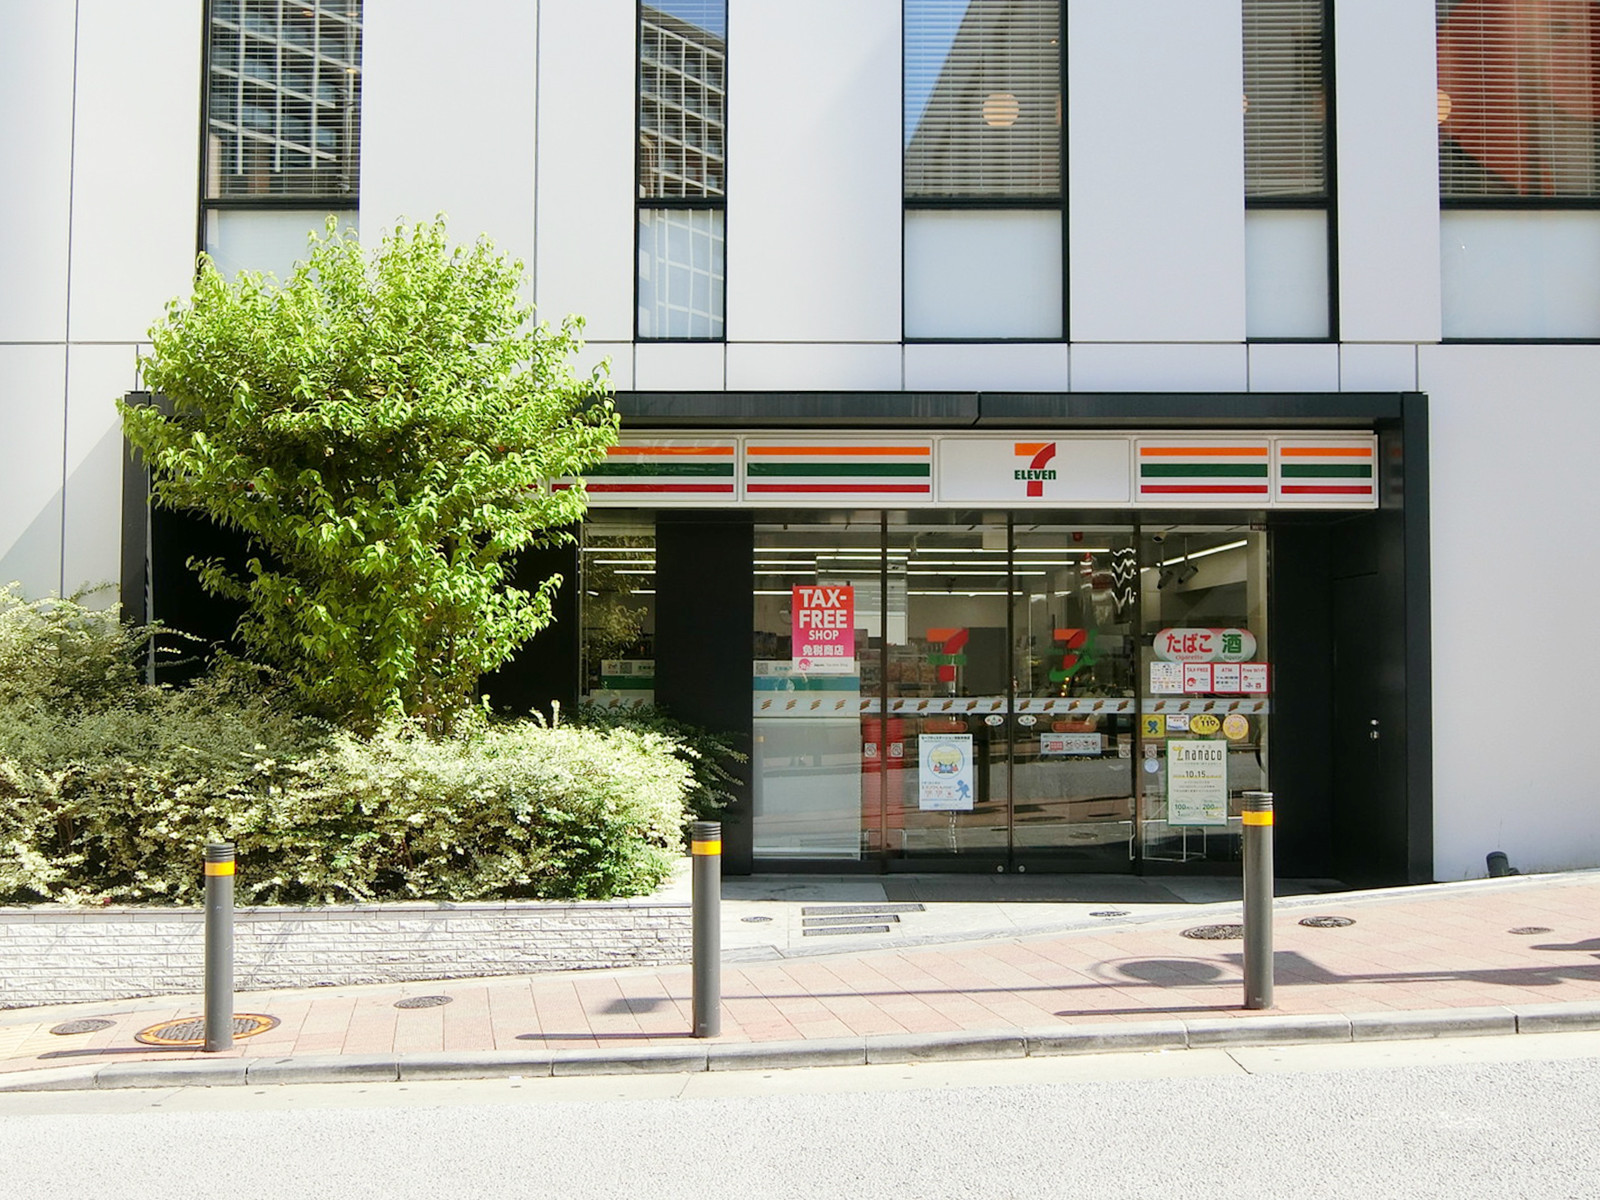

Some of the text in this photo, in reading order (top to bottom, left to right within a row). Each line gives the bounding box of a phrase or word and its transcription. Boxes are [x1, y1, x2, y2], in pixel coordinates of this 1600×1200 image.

[1014, 442, 1056, 497] 7
[799, 589, 847, 608] TAX-
[799, 609, 848, 629] FREE
[808, 629, 839, 641] SHOP
[1166, 633, 1242, 654] たばこ 酒
[1185, 749, 1222, 761] nanaco
